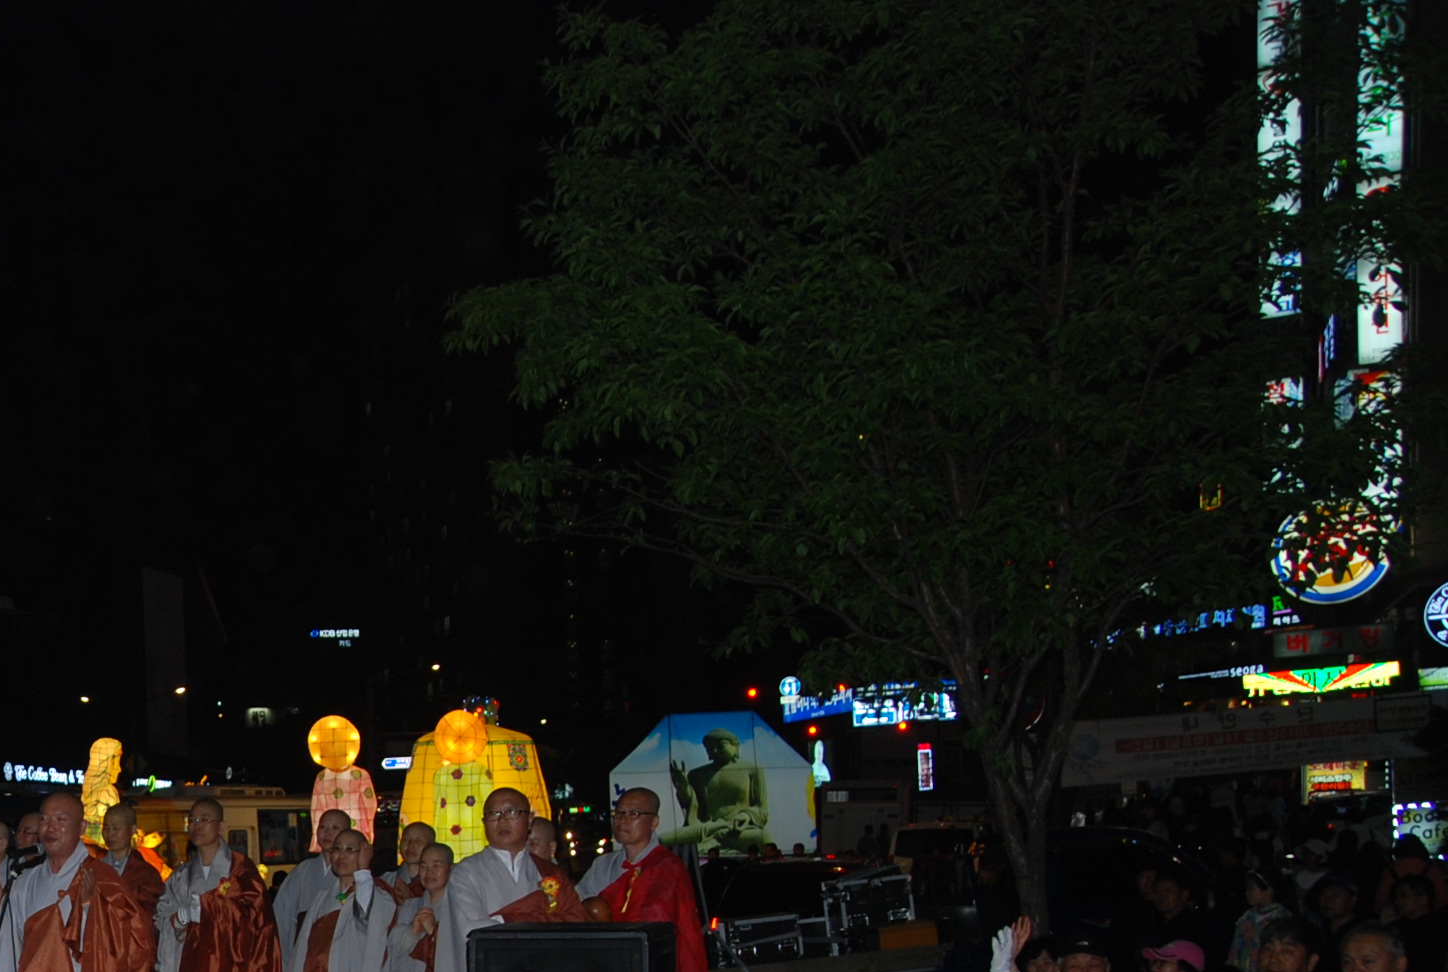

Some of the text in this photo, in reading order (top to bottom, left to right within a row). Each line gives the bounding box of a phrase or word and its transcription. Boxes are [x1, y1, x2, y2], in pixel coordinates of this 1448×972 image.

[1230, 664, 1264, 678] seoga
[14, 764, 27, 781] The
[27, 765, 49, 782] Coffee
[49, 767, 68, 785] Bean
[1400, 810, 1440, 824] Boo
